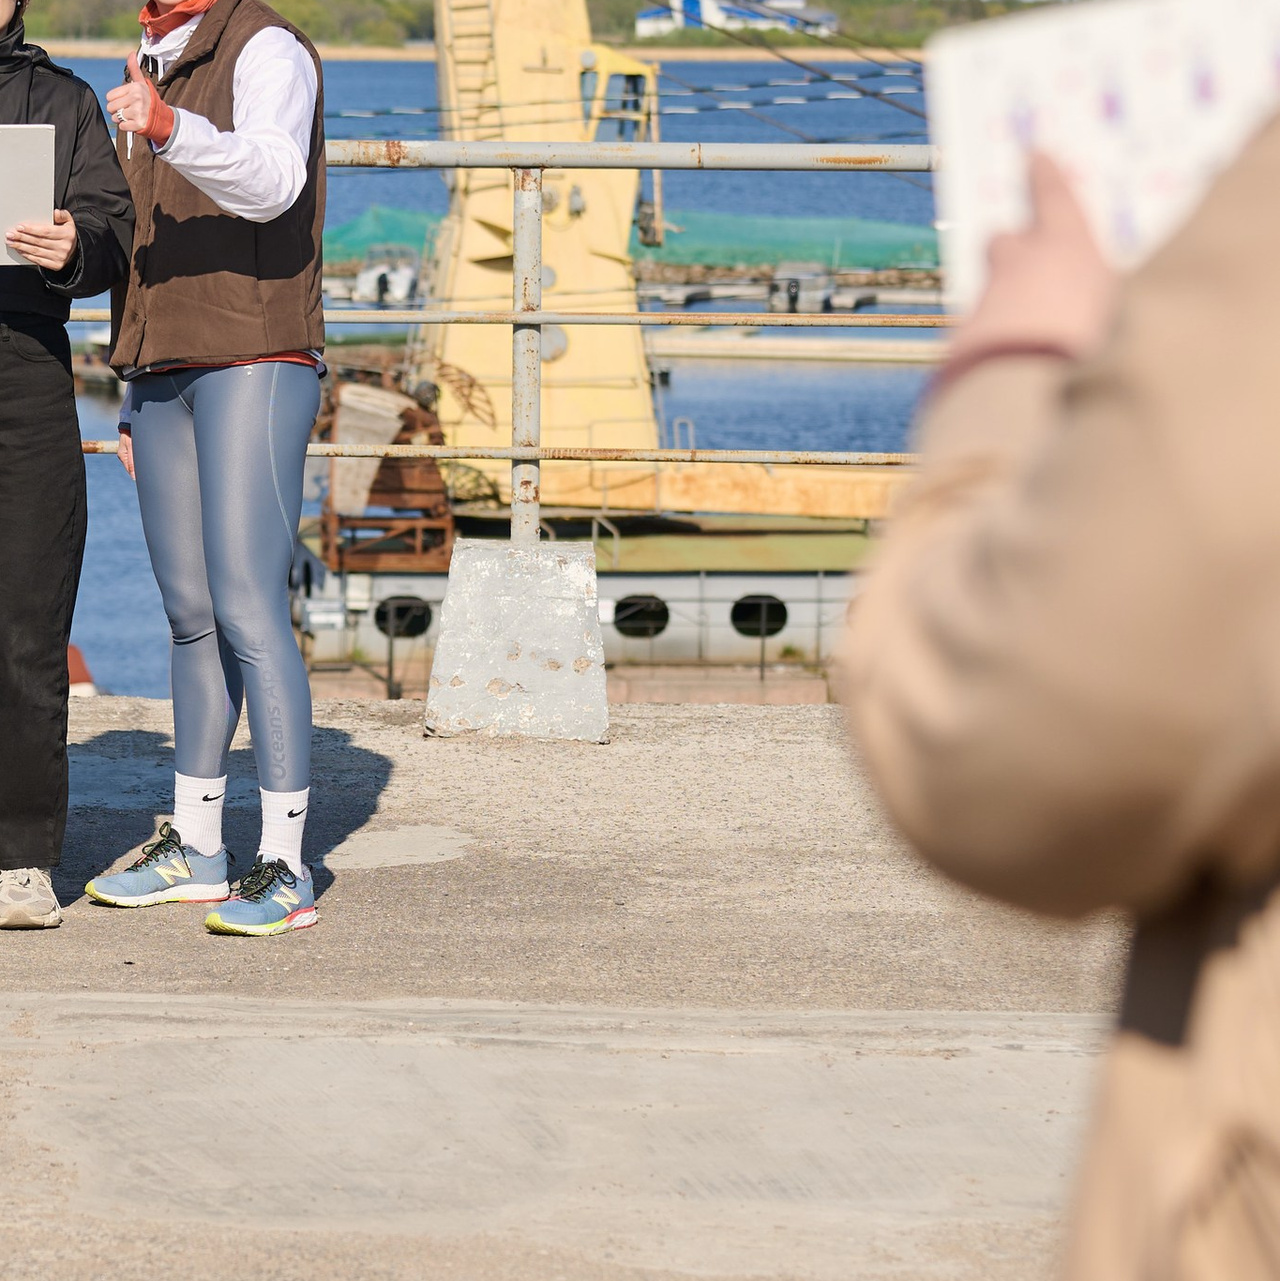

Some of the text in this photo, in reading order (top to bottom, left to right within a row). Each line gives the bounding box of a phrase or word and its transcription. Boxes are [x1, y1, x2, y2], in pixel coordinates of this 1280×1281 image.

[266, 706, 287, 780] Oceans
[154, 858, 193, 885] N
[272, 886, 303, 914] N
